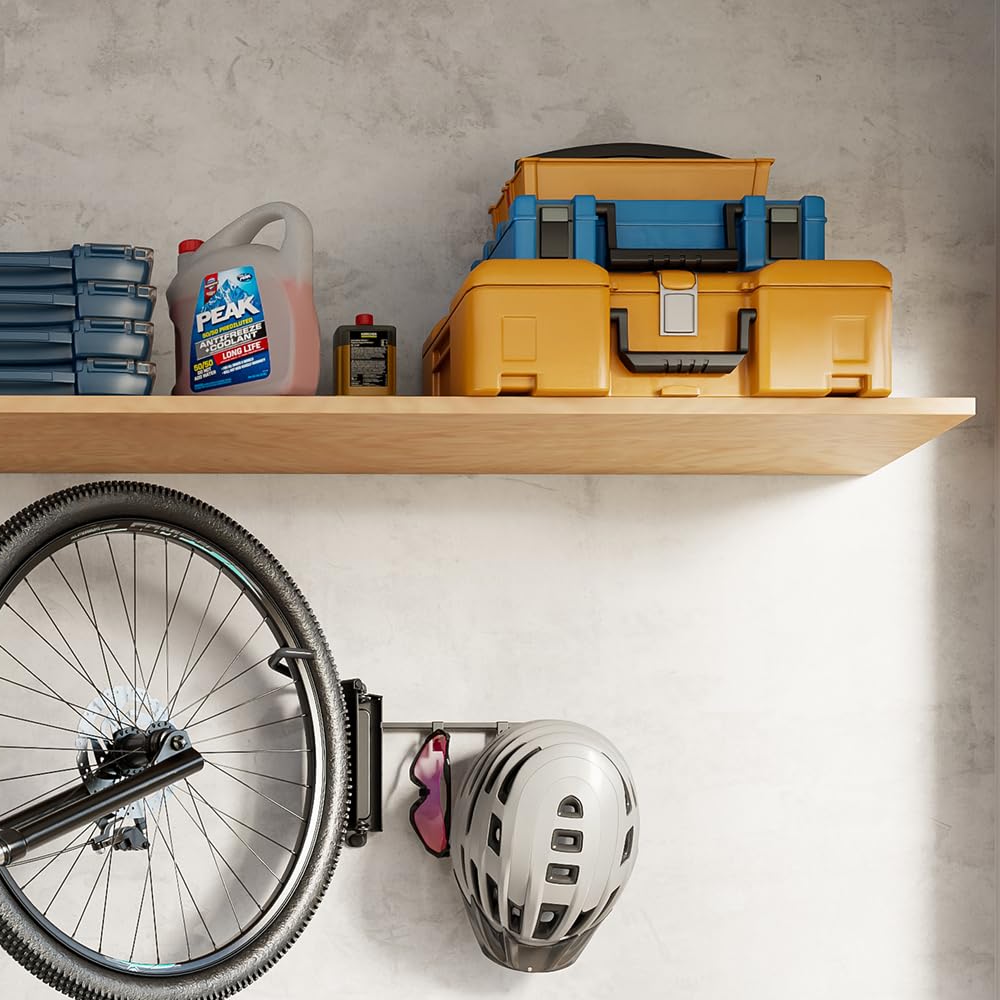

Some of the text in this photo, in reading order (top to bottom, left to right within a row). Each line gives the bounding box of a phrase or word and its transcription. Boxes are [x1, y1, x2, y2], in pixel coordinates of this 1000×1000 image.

[196, 294, 261, 333] PEAK
[200, 322, 263, 349] ANTIFREEZE
[222, 347, 243, 360] LONG
[243, 341, 262, 353] LIFE
[193, 359, 214, 372] 50/50
